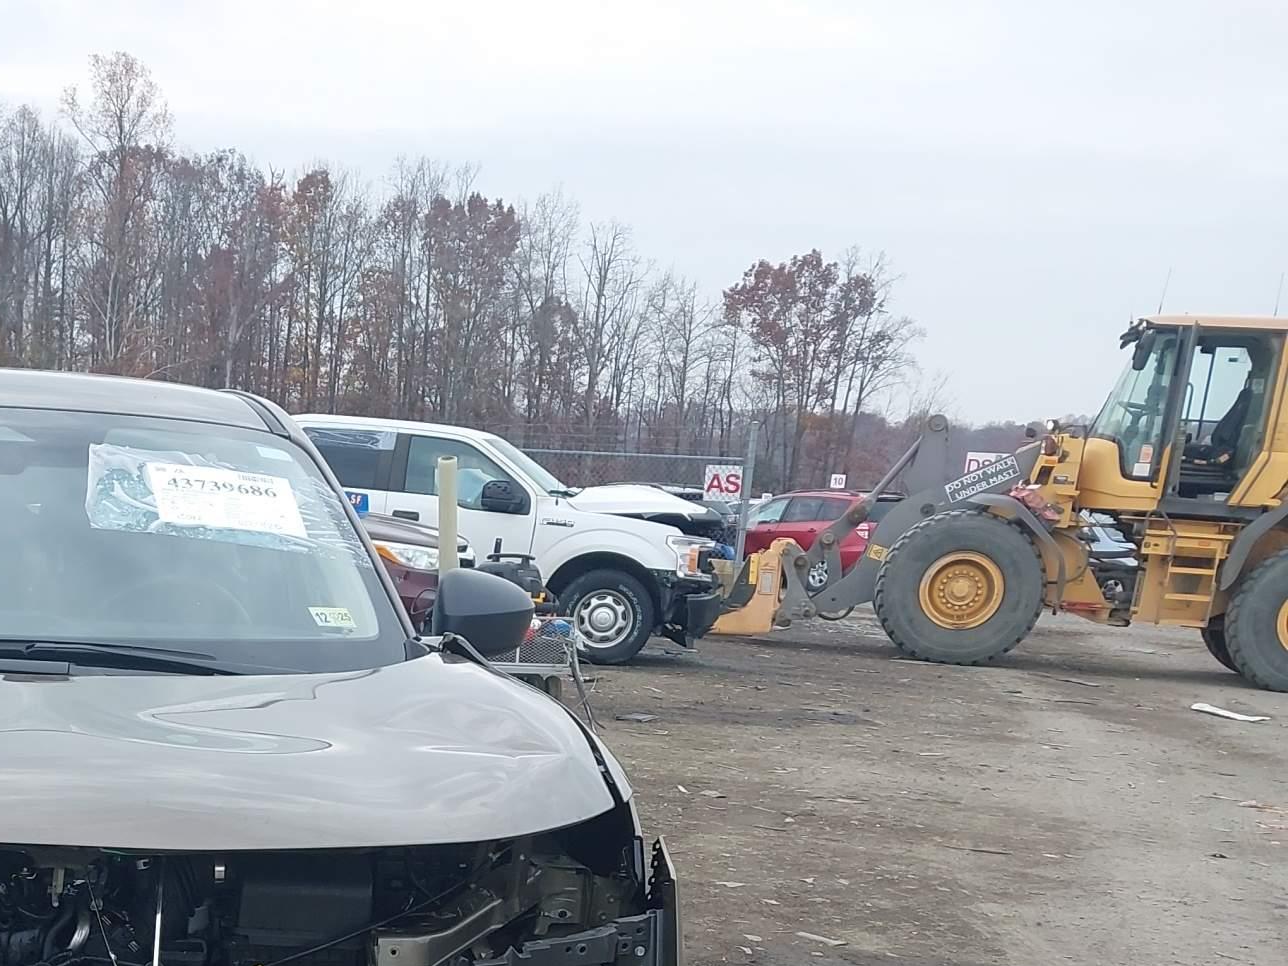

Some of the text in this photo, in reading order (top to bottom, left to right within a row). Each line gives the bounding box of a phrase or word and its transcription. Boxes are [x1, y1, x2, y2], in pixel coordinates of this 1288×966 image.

[706, 473, 741, 493] AS
[833, 477, 844, 486] 10
[947, 457, 1015, 493] DO NOT WALK
[955, 468, 1015, 499] UNDER MAST
[168, 477, 278, 498] 43739686
[315, 612, 352, 623] 12 25
